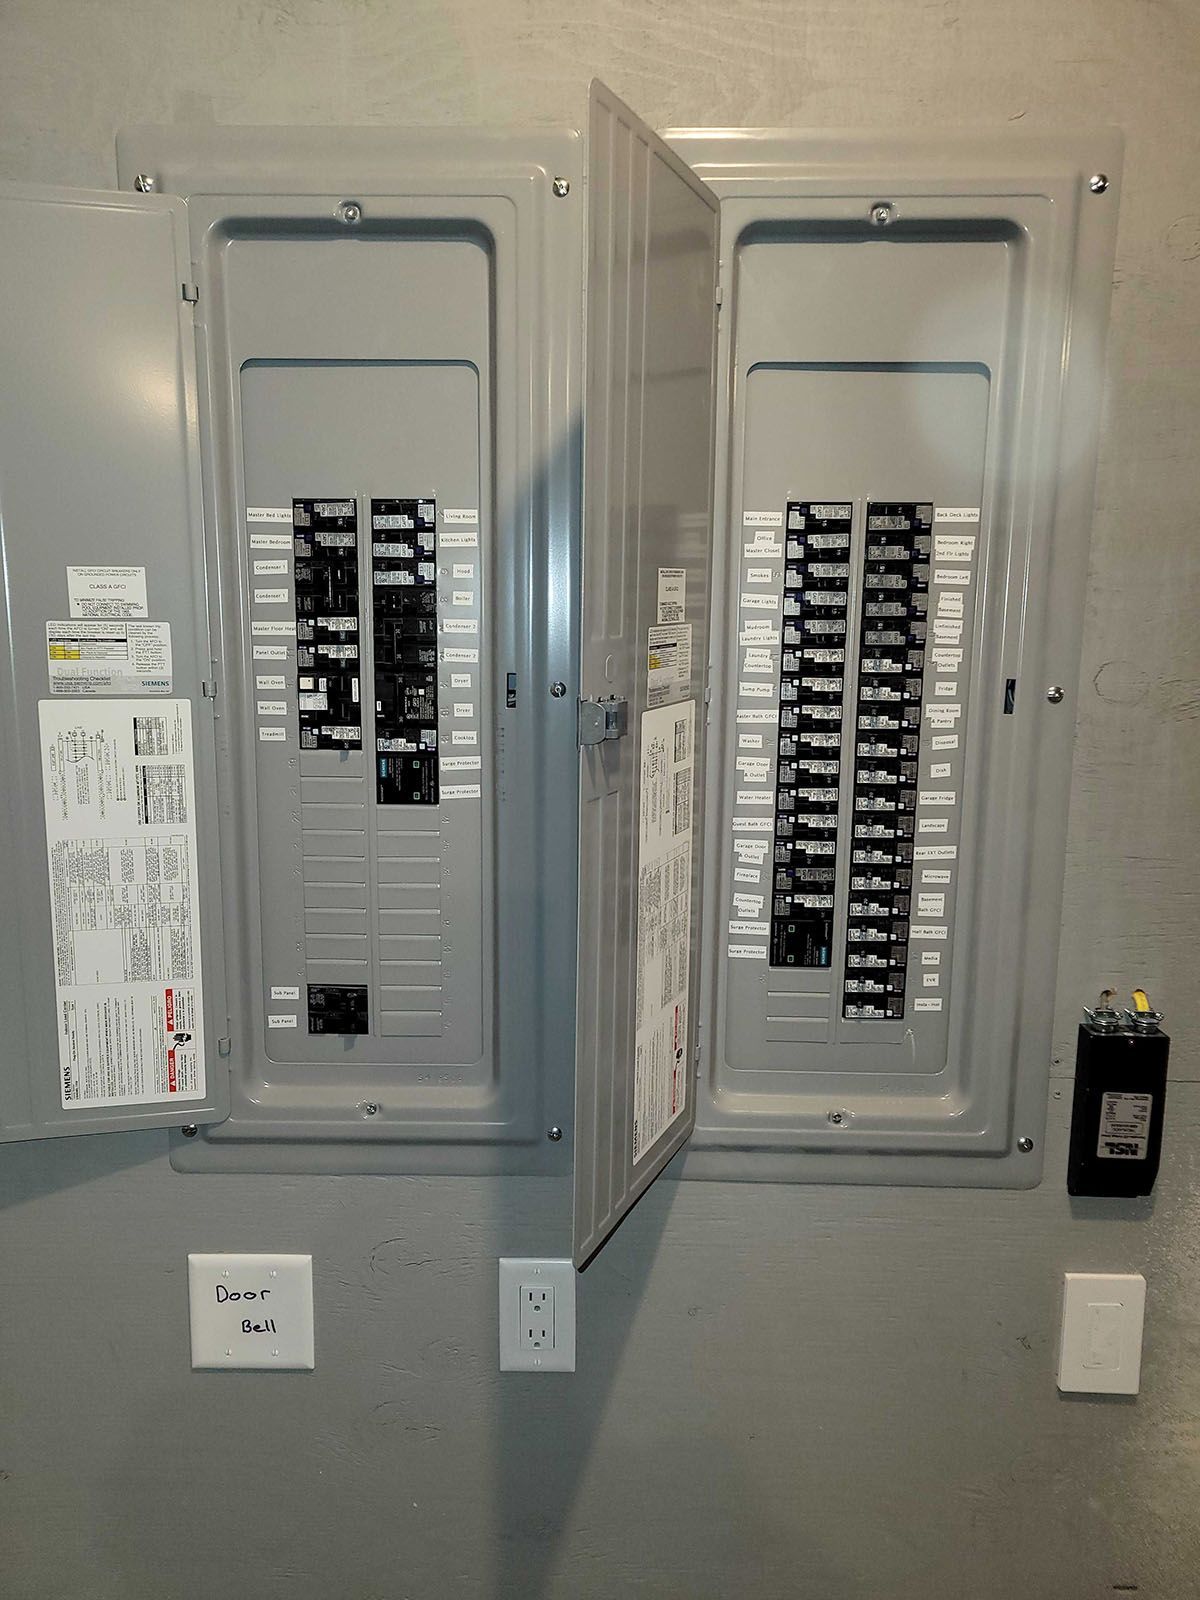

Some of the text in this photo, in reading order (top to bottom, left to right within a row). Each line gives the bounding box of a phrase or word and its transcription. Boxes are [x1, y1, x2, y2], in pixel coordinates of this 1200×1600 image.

[276, 512, 292, 520] Lights
[56, 667, 123, 677] Dual Function
[441, 760, 456, 768] Surge
[215, 1284, 271, 1303] Door
[241, 1319, 277, 1333] Bell
